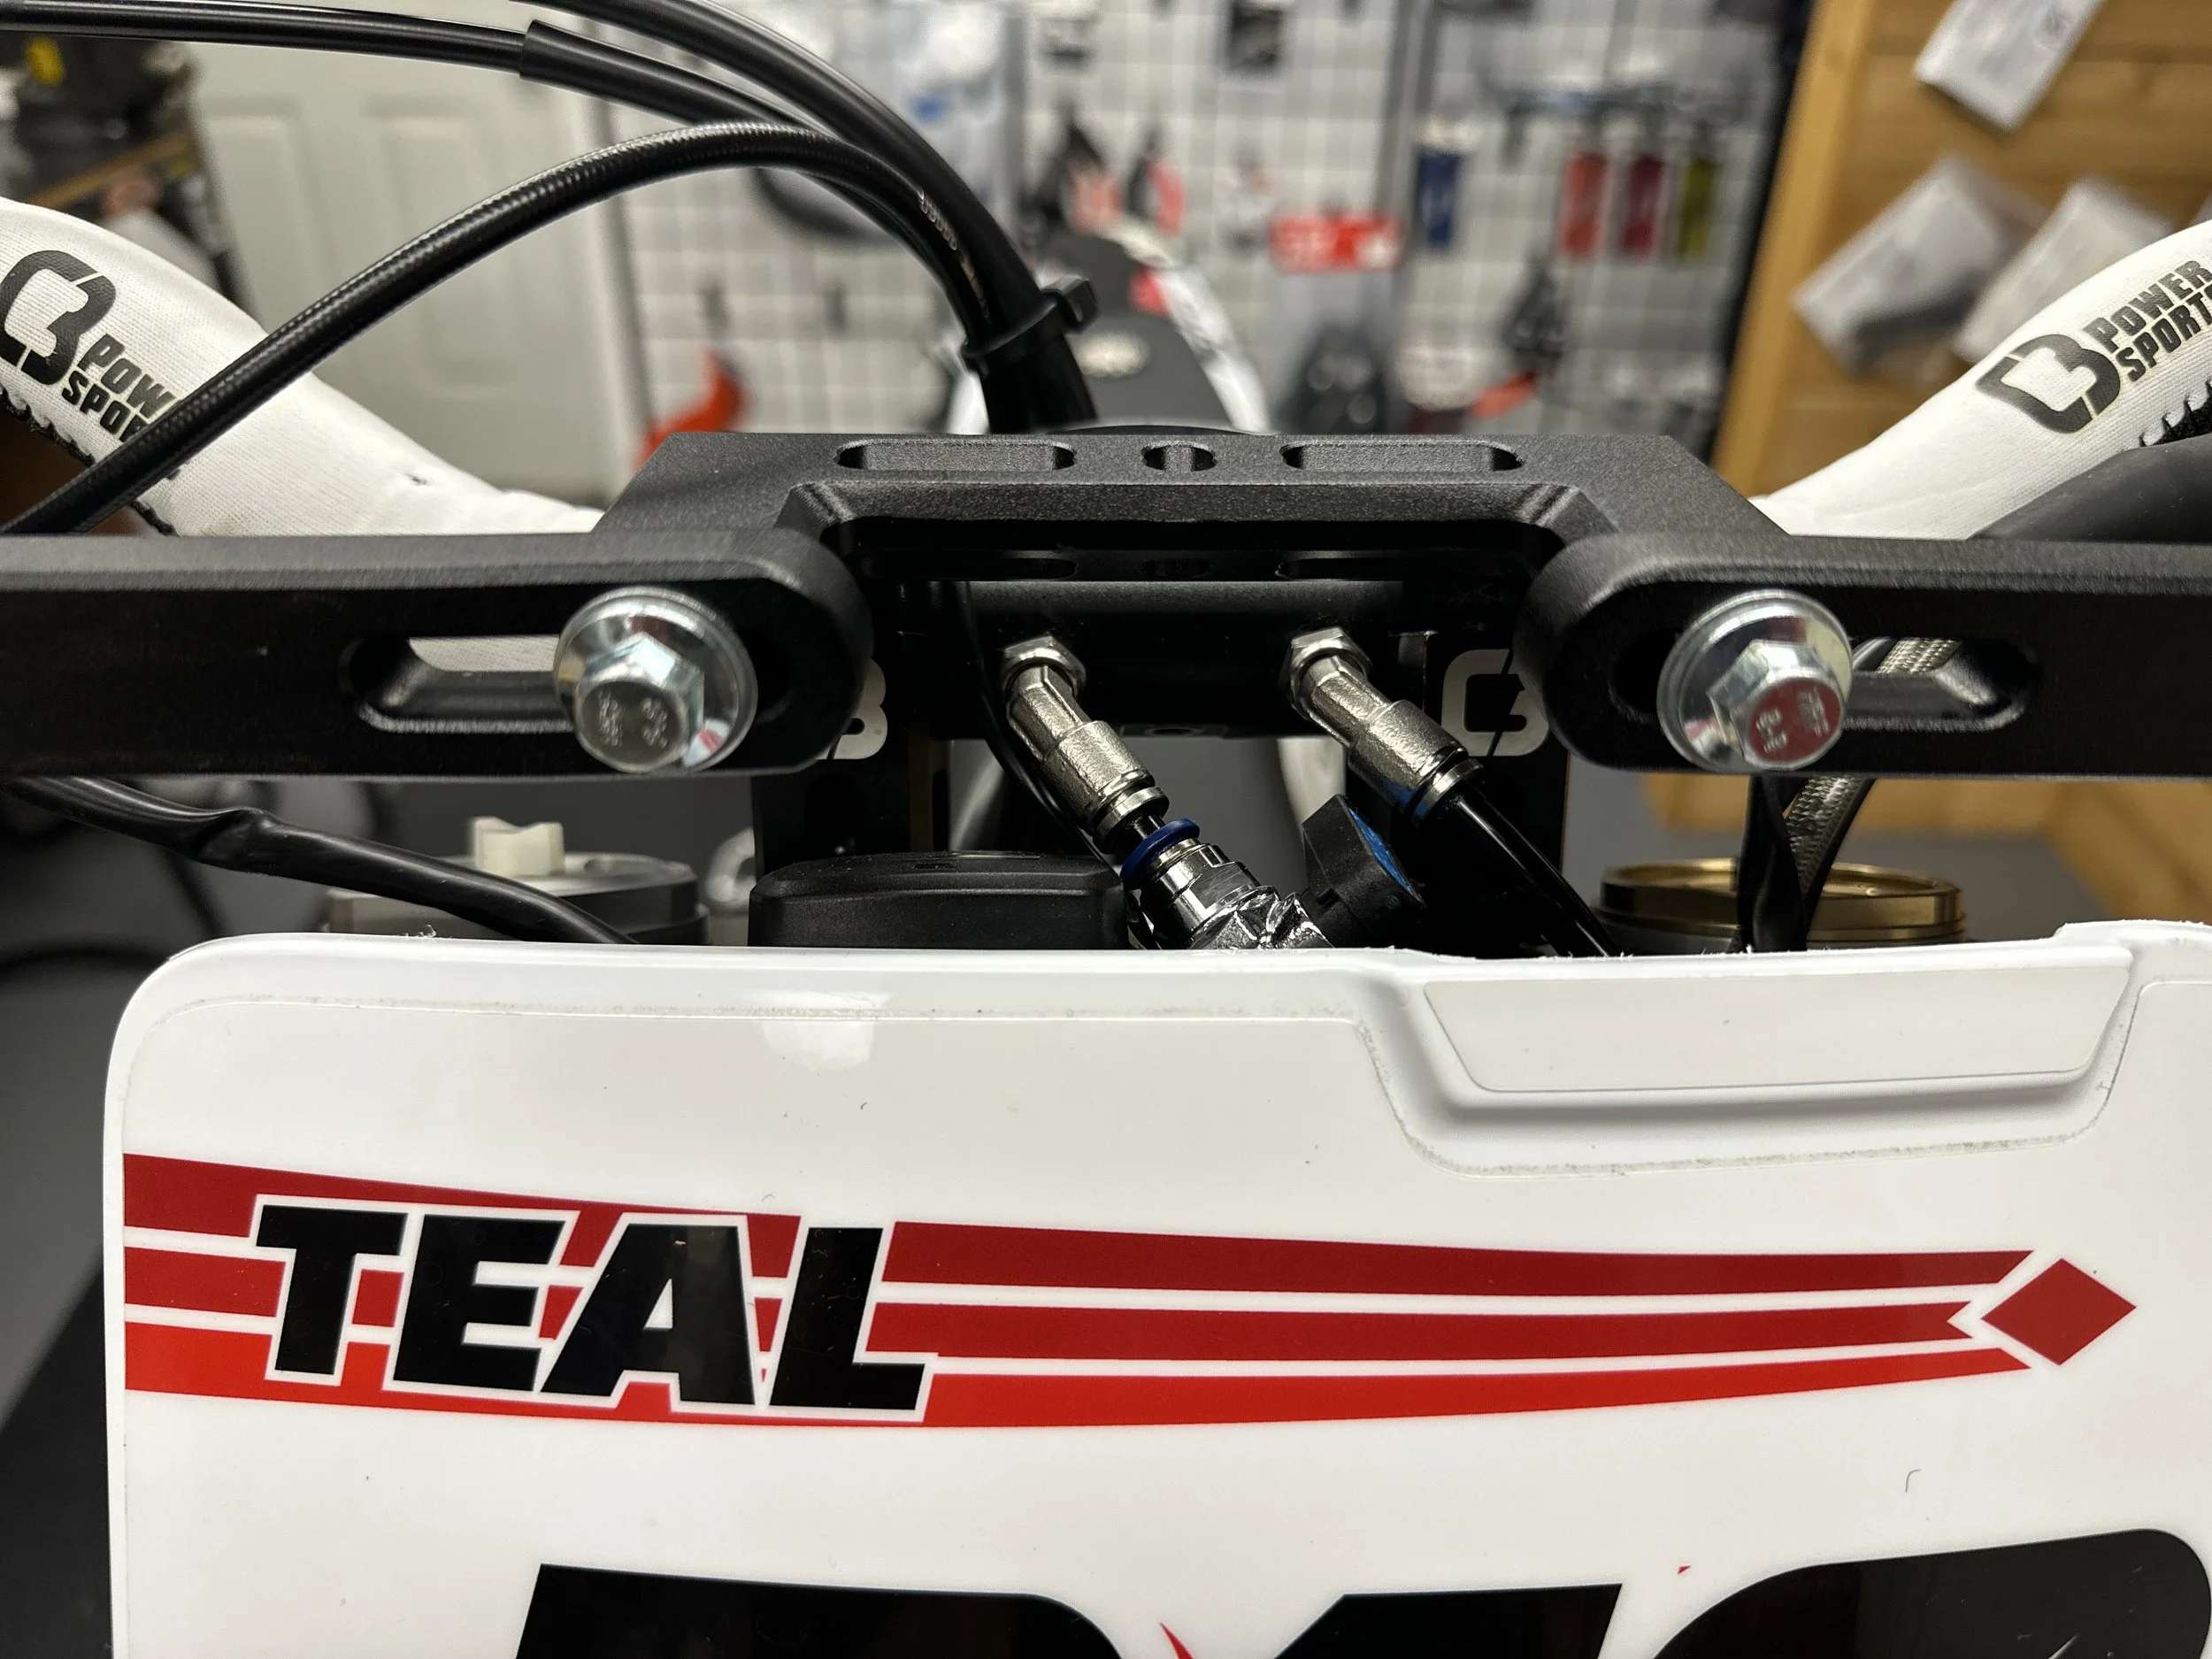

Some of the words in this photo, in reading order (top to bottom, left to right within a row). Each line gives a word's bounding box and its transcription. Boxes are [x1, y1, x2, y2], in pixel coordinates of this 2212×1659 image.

[2082, 260, 2212, 354] POWER
[2116, 283, 2212, 382] SPORT
[77, 334, 176, 419] POW
[253, 1202, 929, 1414] TEAL
